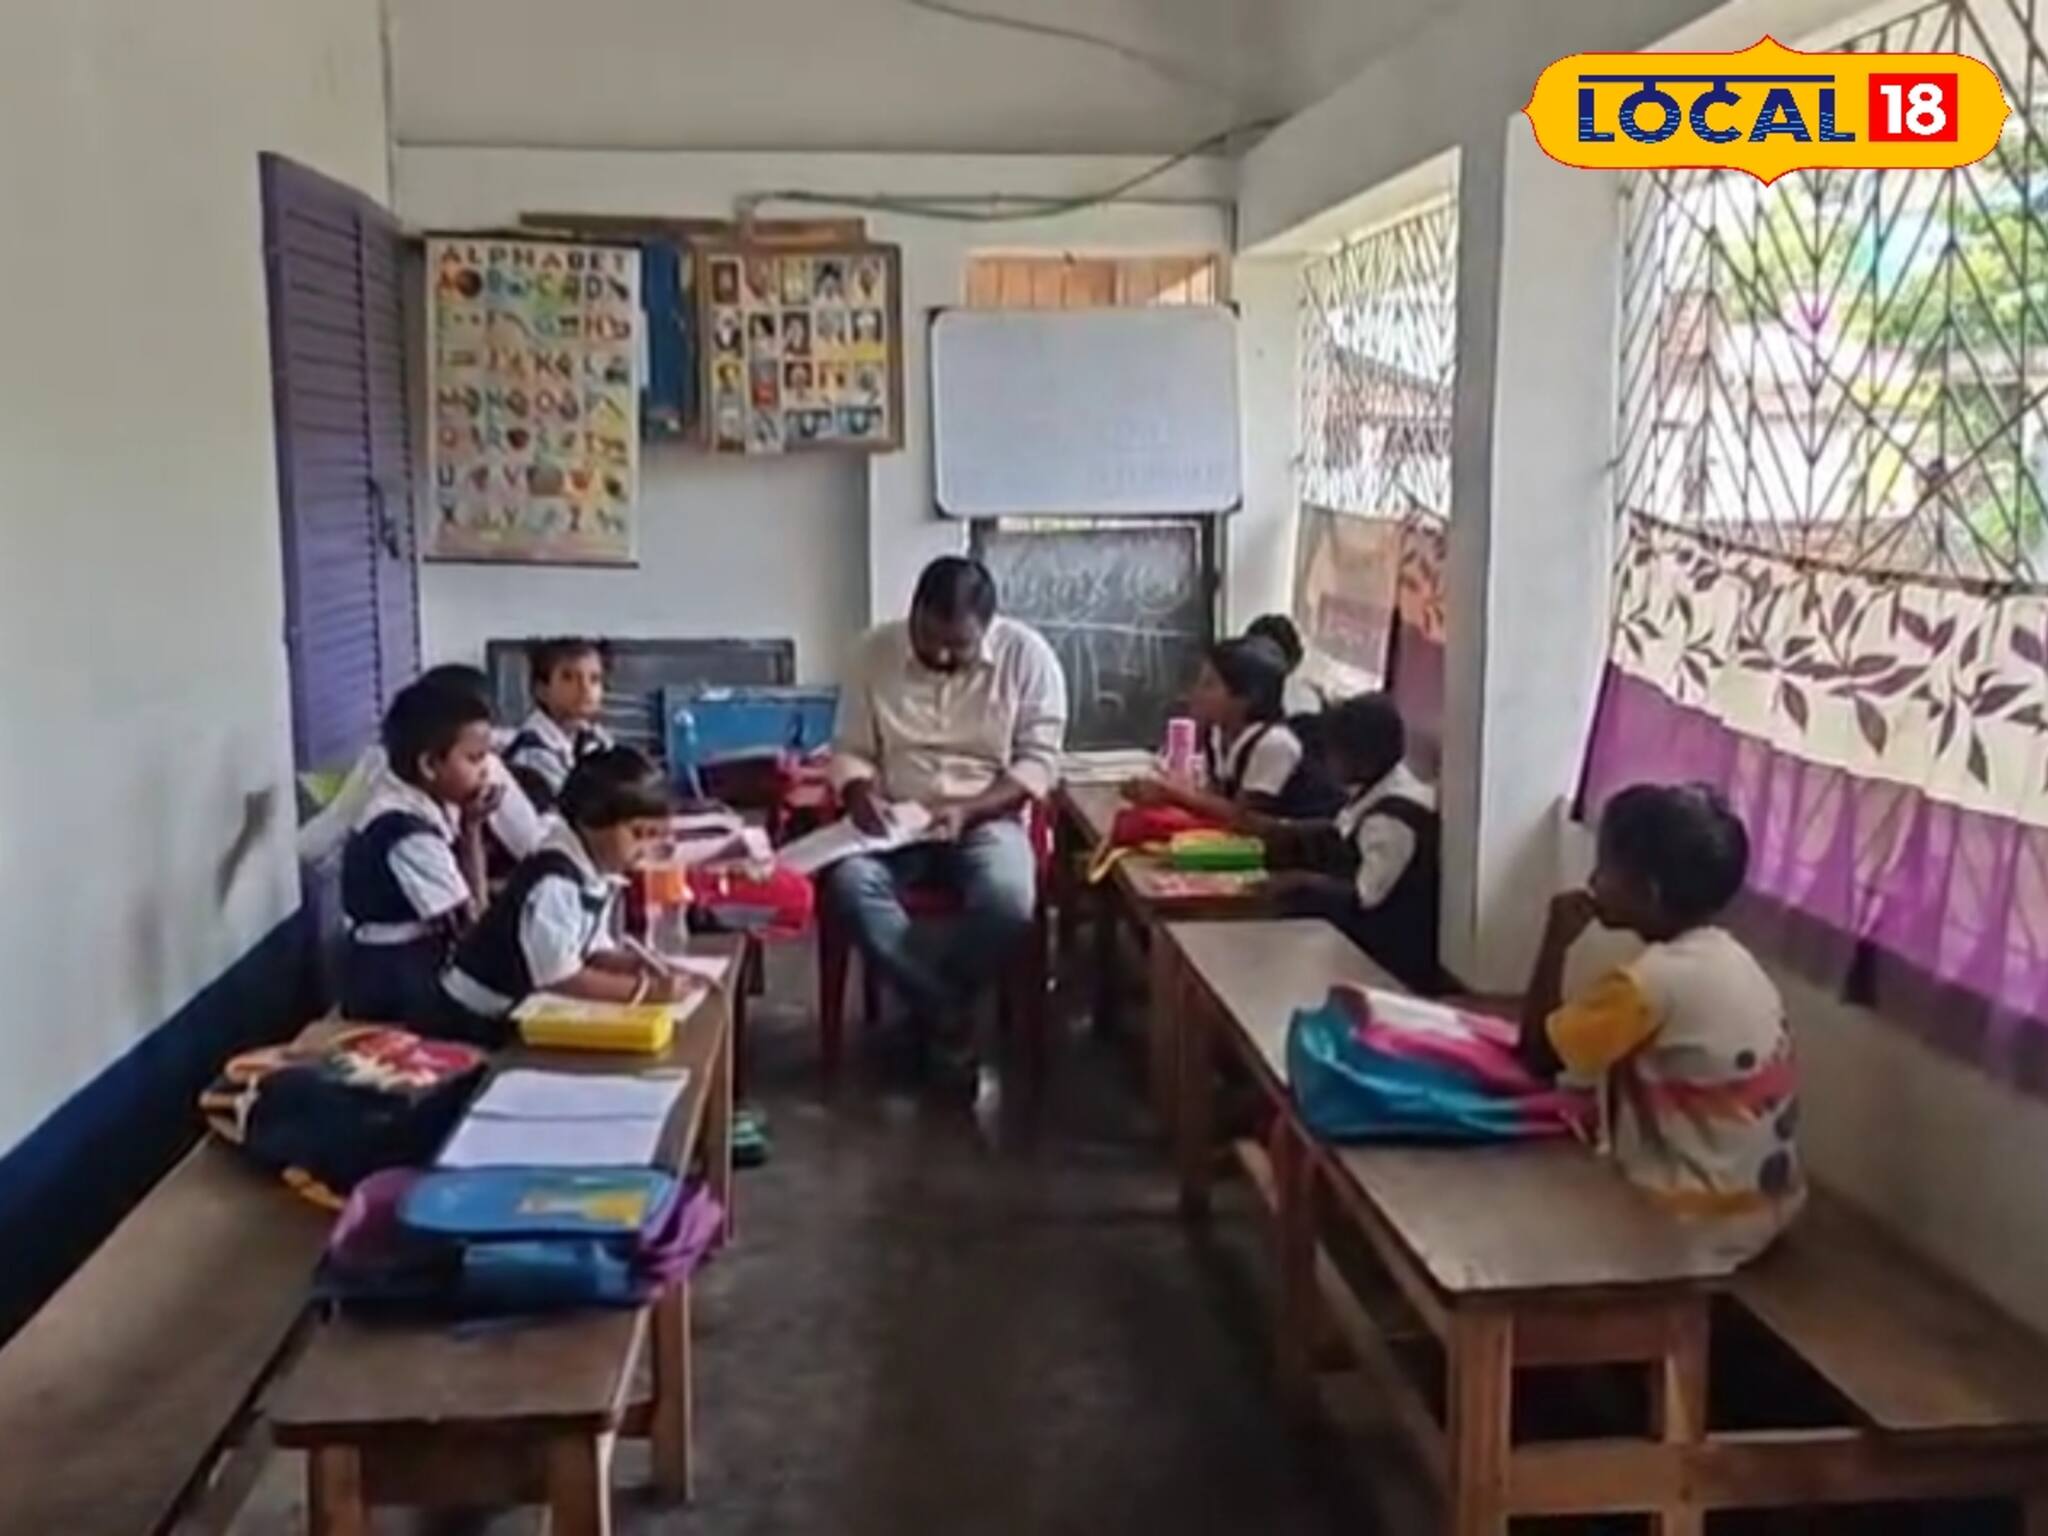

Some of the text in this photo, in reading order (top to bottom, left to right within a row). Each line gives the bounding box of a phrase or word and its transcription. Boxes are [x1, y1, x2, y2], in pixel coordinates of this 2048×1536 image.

[440, 246, 626, 273] ALPHABET
[586, 273, 603, 300] D
[437, 464, 456, 487] U
